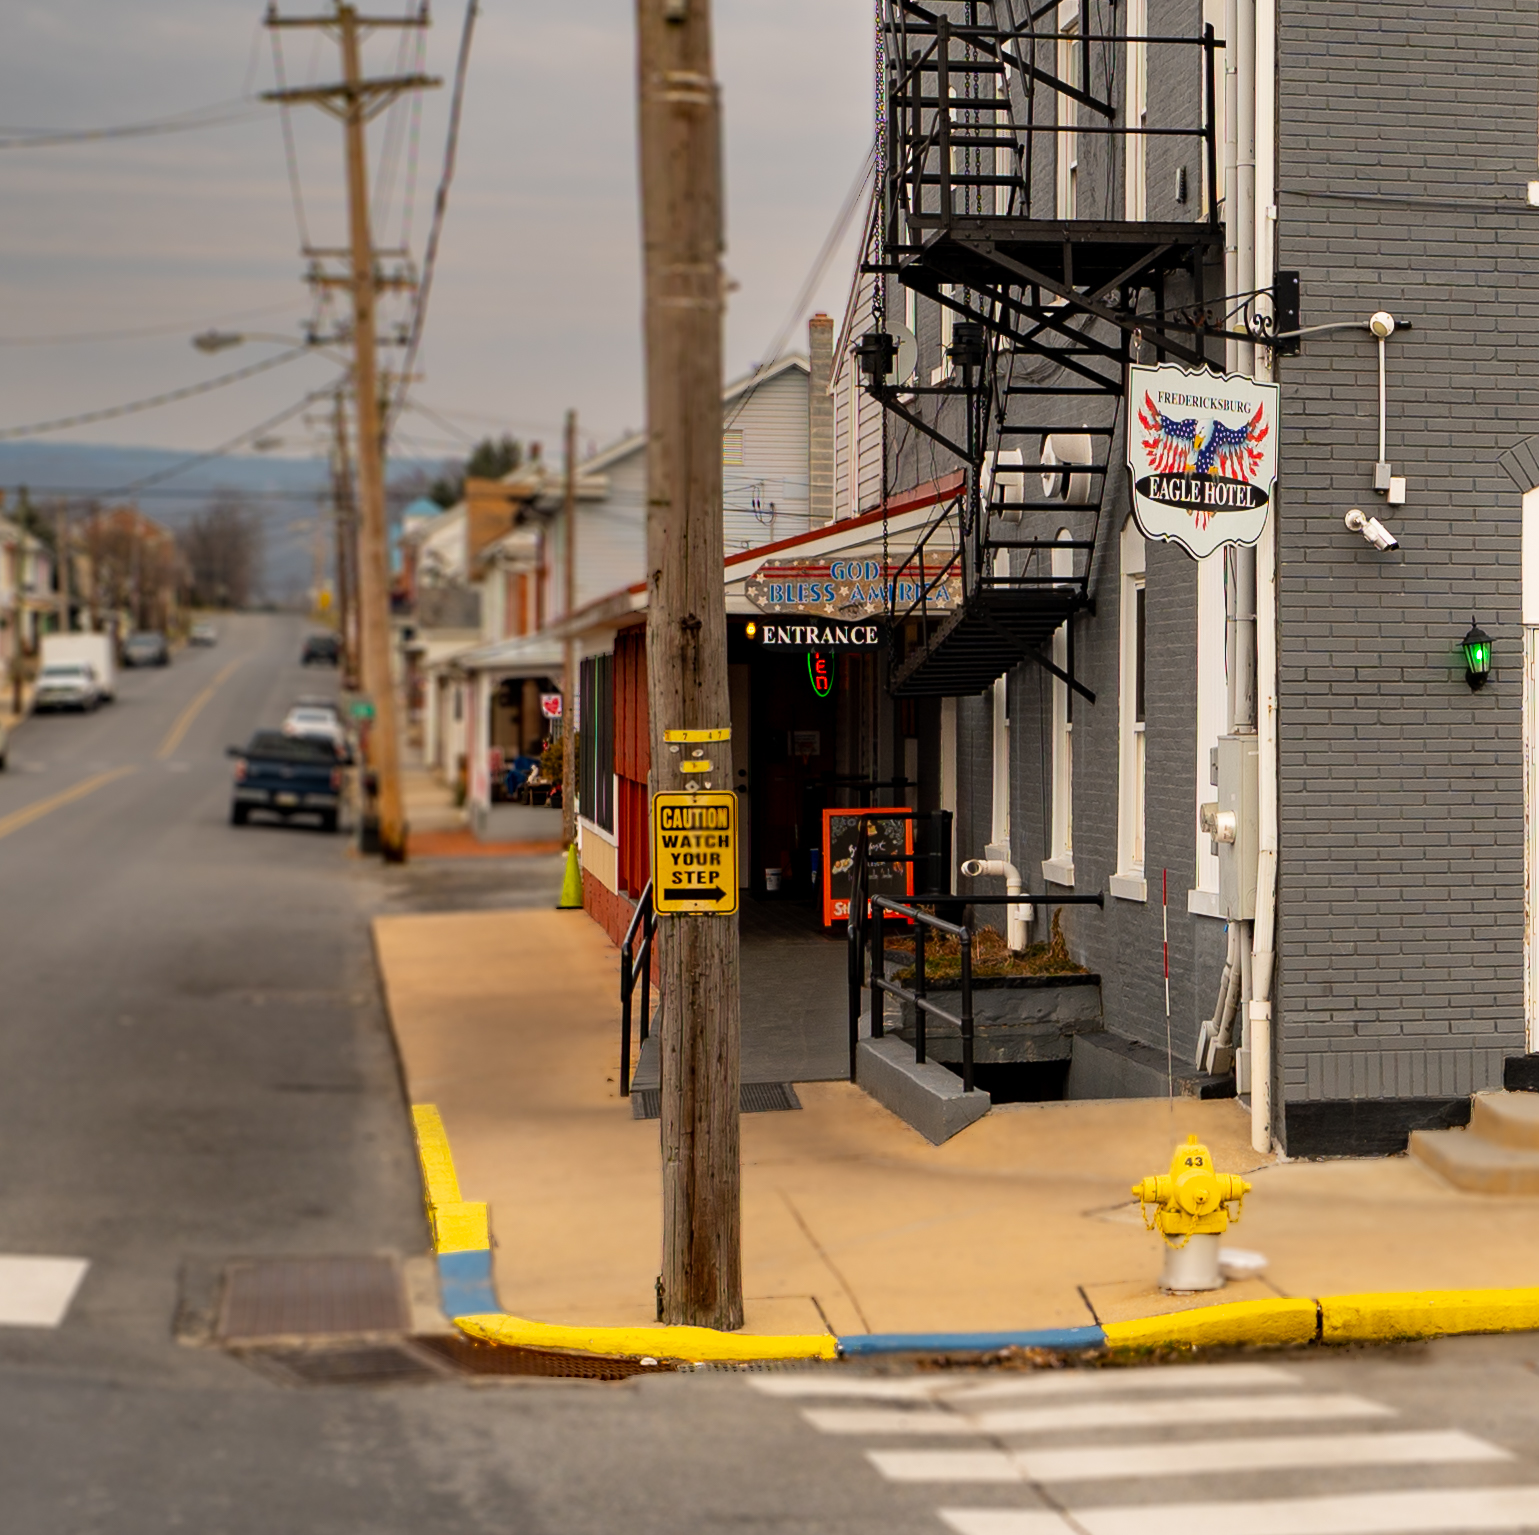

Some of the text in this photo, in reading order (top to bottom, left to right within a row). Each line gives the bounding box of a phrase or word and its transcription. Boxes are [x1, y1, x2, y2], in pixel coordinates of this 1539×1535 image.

[1157, 390, 1252, 414] FREDERICKSBURG
[1149, 476, 1256, 508] EAGLE HOTEL
[830, 561, 880, 581] GOD
[769, 583, 836, 603] BLESS
[762, 625, 879, 645] ENTRANCE
[662, 807, 728, 830] CAUTION
[662, 835, 730, 848] WATCH
[671, 852, 721, 866] YOUR
[671, 870, 720, 885] STEP
[1184, 1156, 1204, 1167] 43
